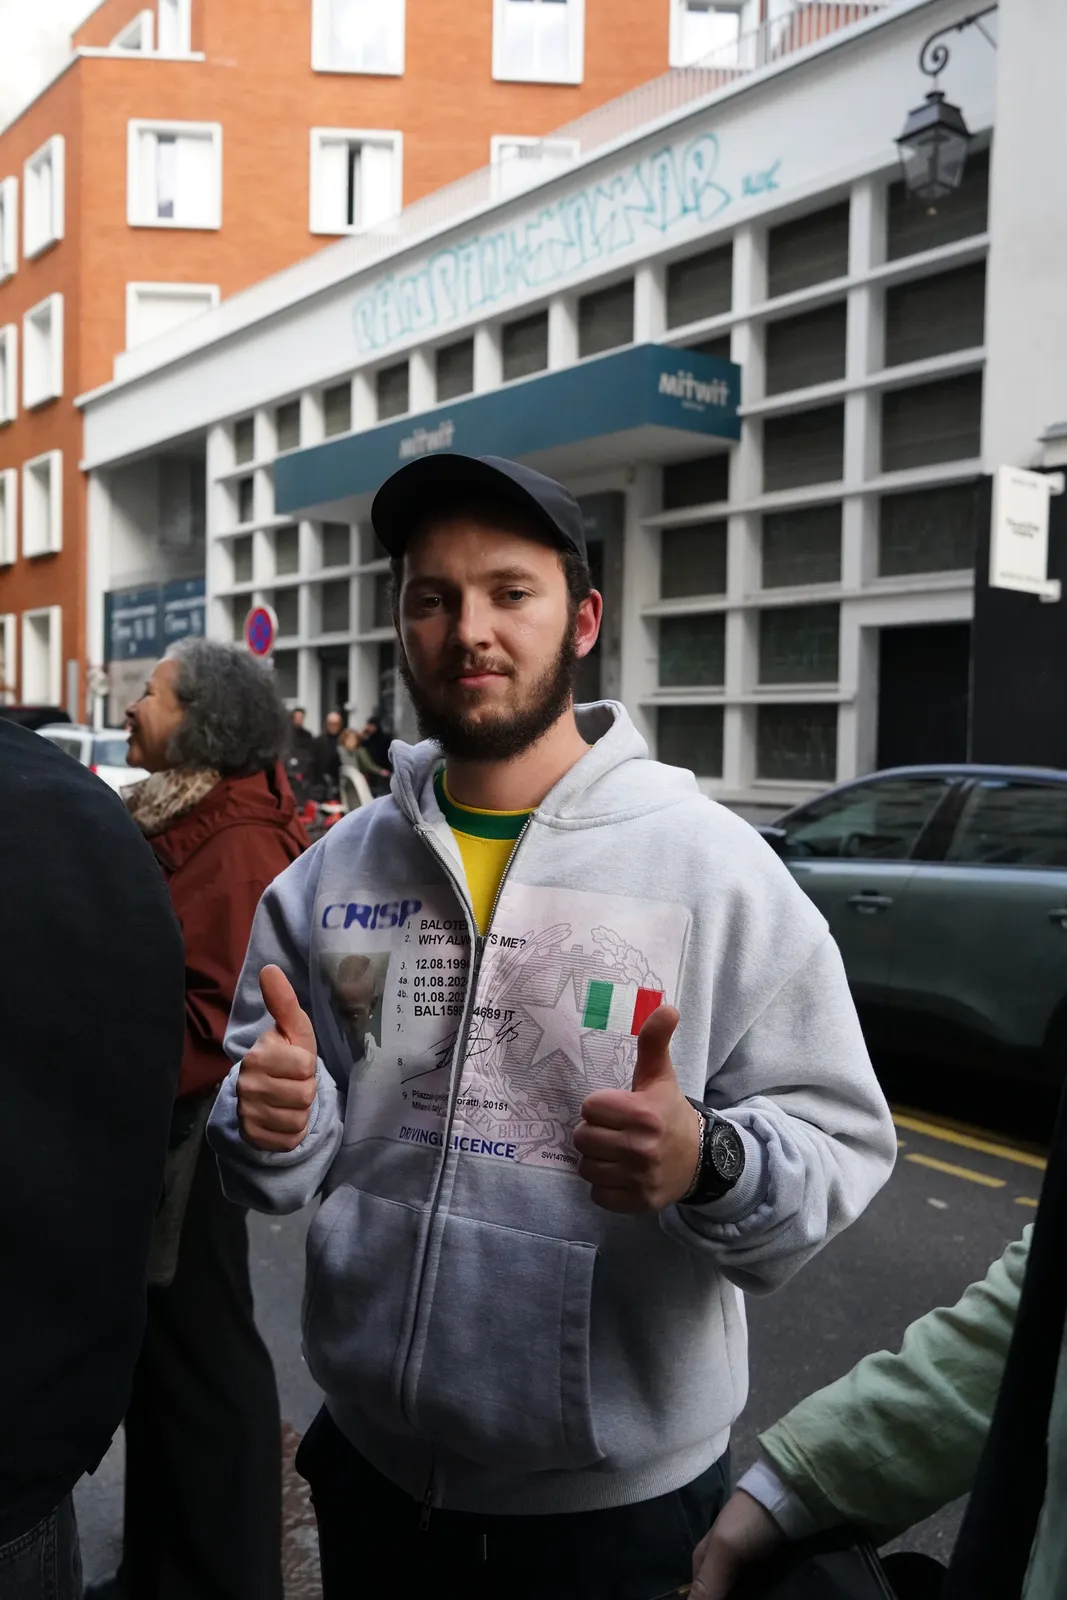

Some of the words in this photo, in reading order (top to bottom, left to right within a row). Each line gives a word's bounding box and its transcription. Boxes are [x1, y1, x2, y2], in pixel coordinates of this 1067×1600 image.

[321, 899, 423, 931] CRISP
[420, 919, 468, 931] BALOTE
[404, 934, 412, 943] 2.
[418, 934, 445, 946] WHY
[499, 936, 526, 949] ME?
[400, 960, 407, 970] 3.
[413, 976, 468, 988] 01.08.202
[413, 991, 465, 1003] 01.08.203
[503, 1010, 516, 1021] IT
[456, 1097, 481, 1108] oratti,
[483, 1100, 508, 1111] 20151
[399, 1126, 438, 1146] DRIVING
[439, 1134, 517, 1158] LICENCE
